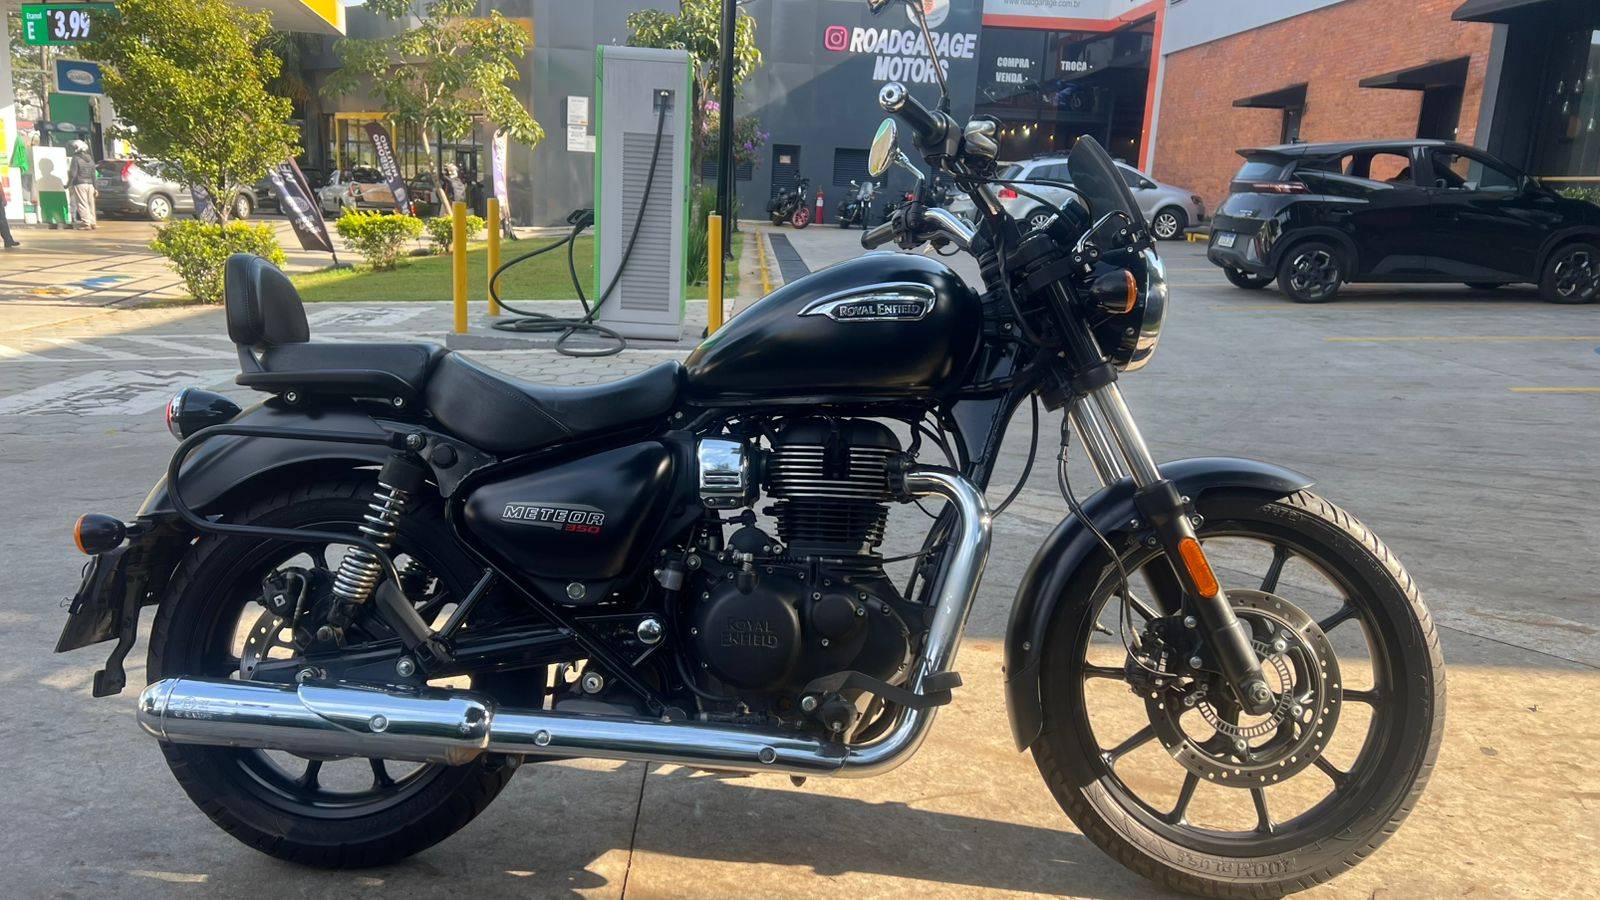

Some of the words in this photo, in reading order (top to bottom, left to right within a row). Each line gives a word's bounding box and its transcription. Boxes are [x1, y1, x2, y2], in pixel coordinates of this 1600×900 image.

[27, 21, 36, 39] E
[54, 10, 90, 39] 3,99
[849, 27, 977, 59] ROADGARAGE
[873, 56, 949, 83] MOTORS
[997, 57, 1029, 68] COMPRA
[1060, 60, 1087, 72] TROCA
[995, 72, 1023, 84] VENDA
[373, 134, 394, 183] CARBONO
[840, 305, 876, 317] ROYAL
[877, 303, 921, 316] ENFIELD
[502, 505, 605, 526] METEOR
[564, 523, 601, 534] 350
